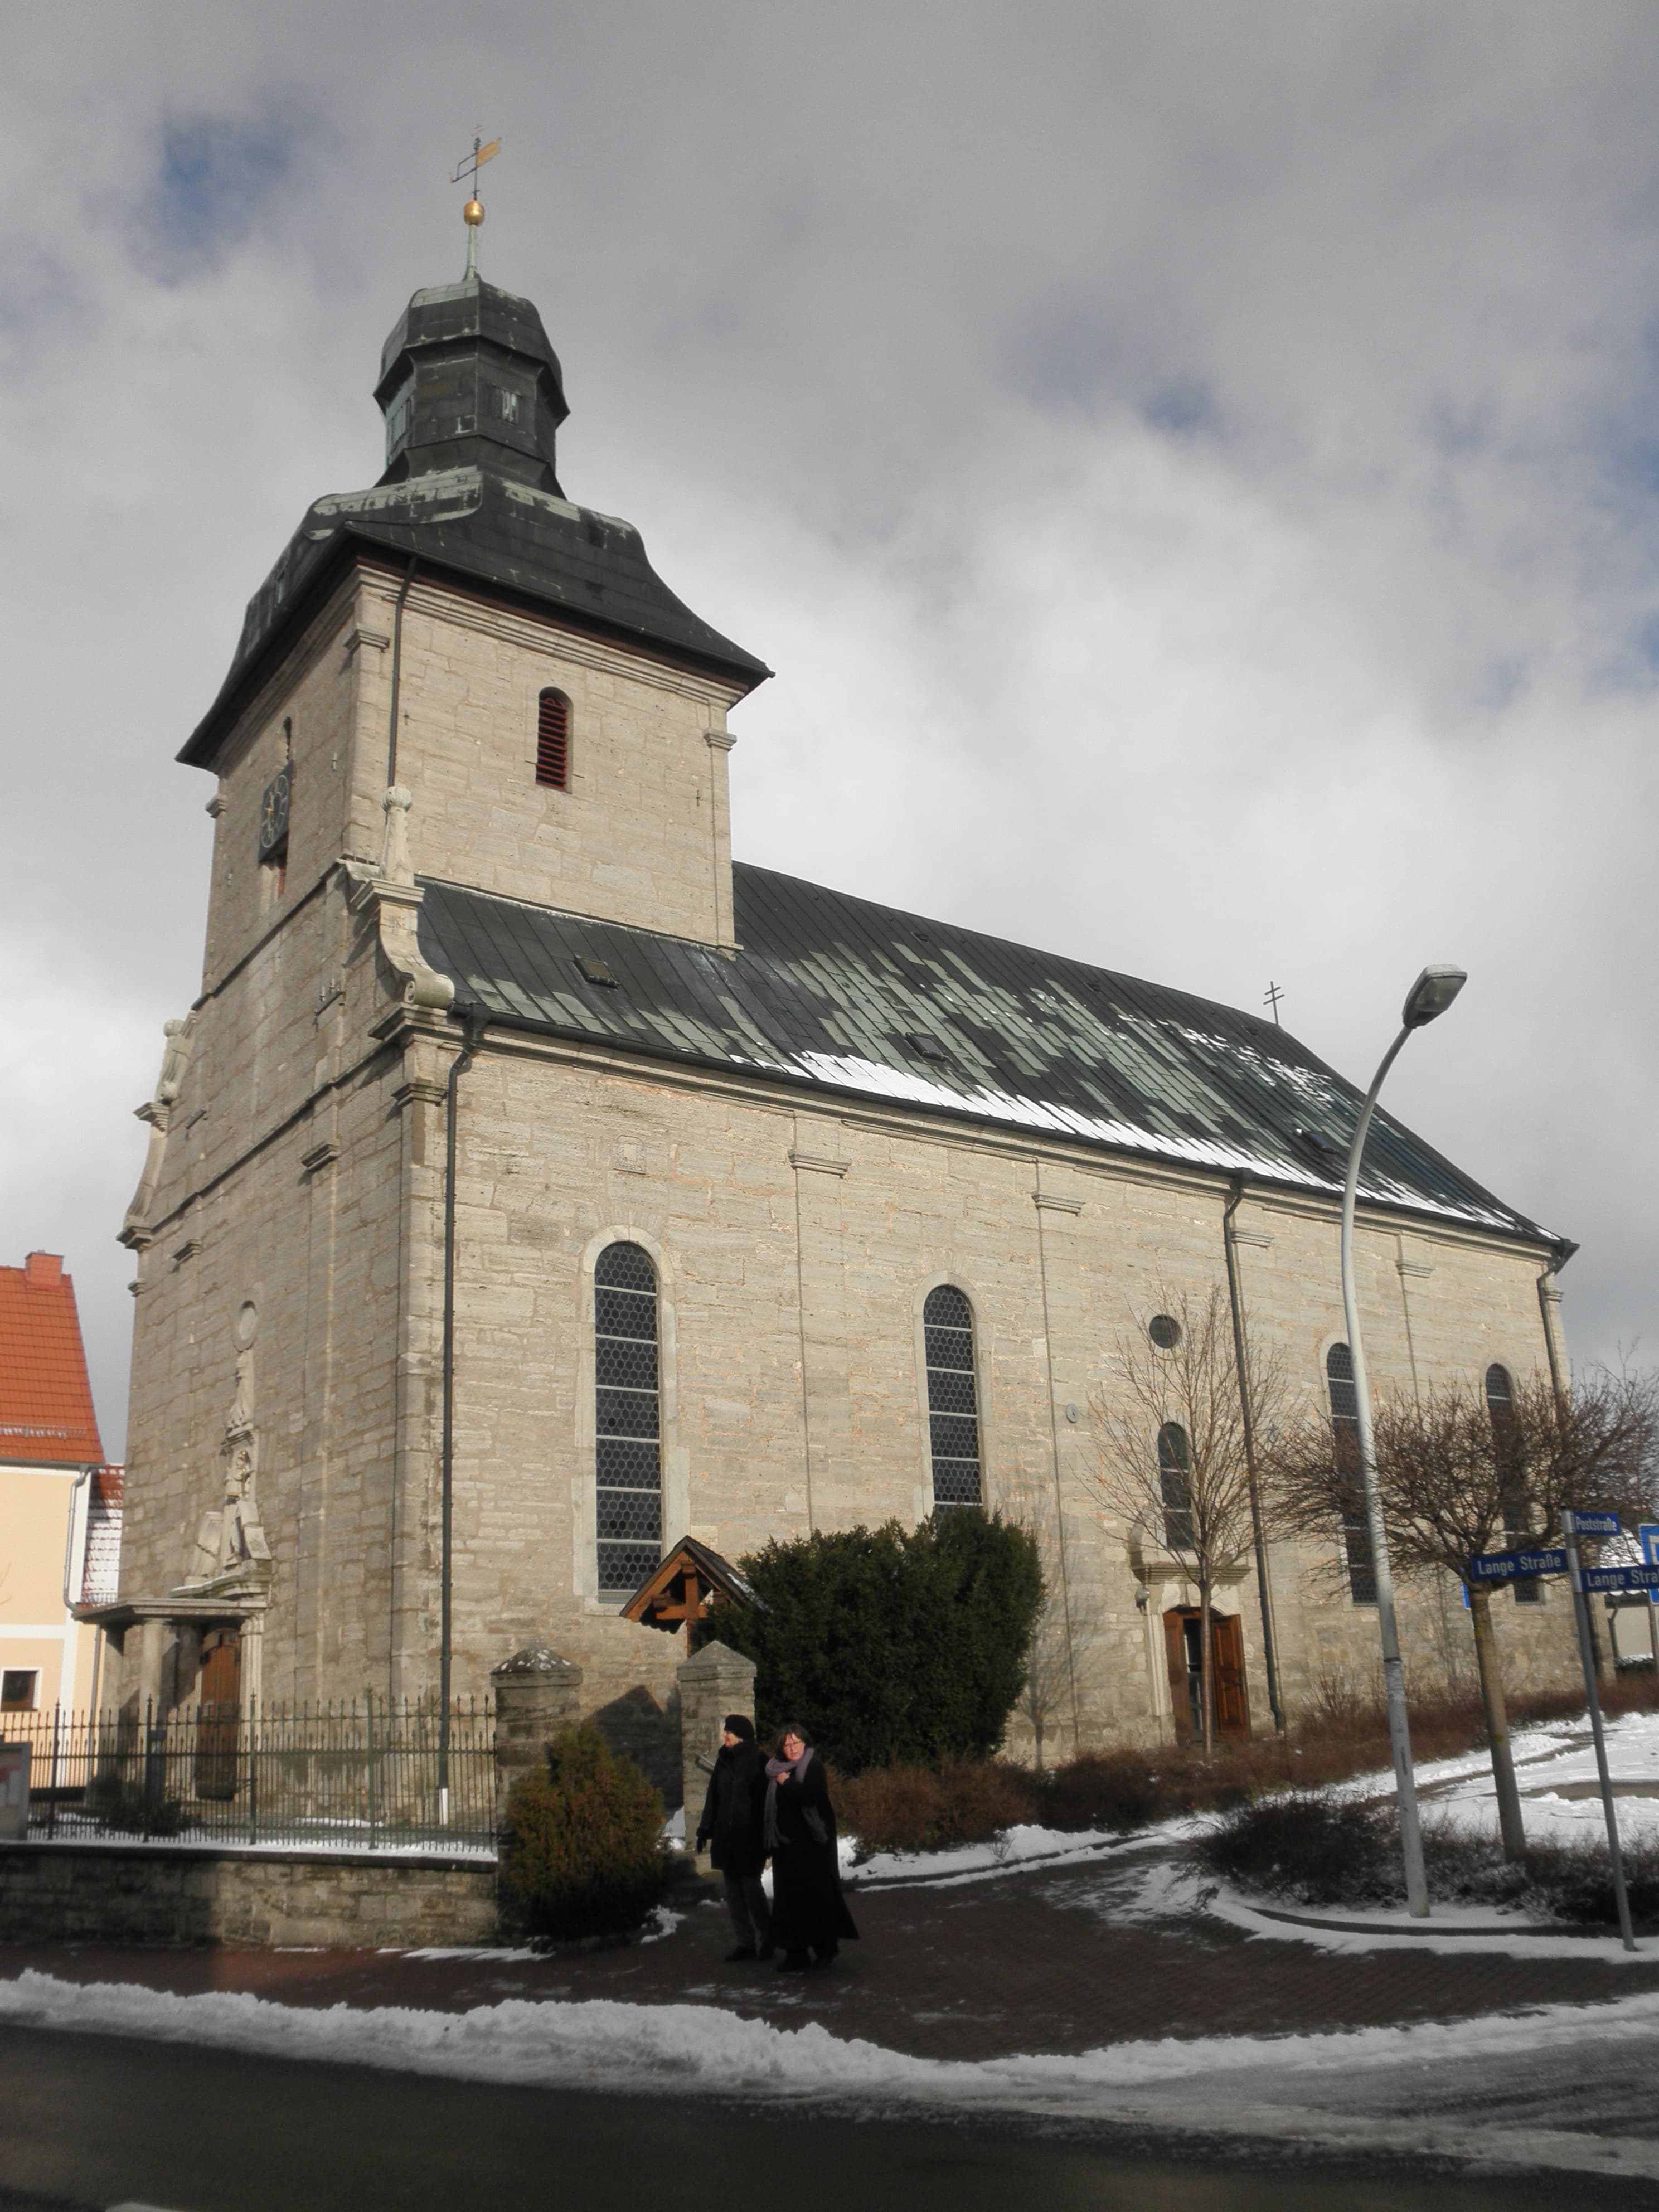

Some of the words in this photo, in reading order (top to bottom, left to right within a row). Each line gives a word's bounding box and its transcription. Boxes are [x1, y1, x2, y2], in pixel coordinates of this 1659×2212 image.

[1576, 1516, 1617, 1531] Poststraße
[1478, 1561, 1515, 1576] Lange
[1520, 1554, 1561, 1570] Straße
[1587, 1573, 1625, 1589] Lange
[1631, 1569, 1659, 1584] Stra
